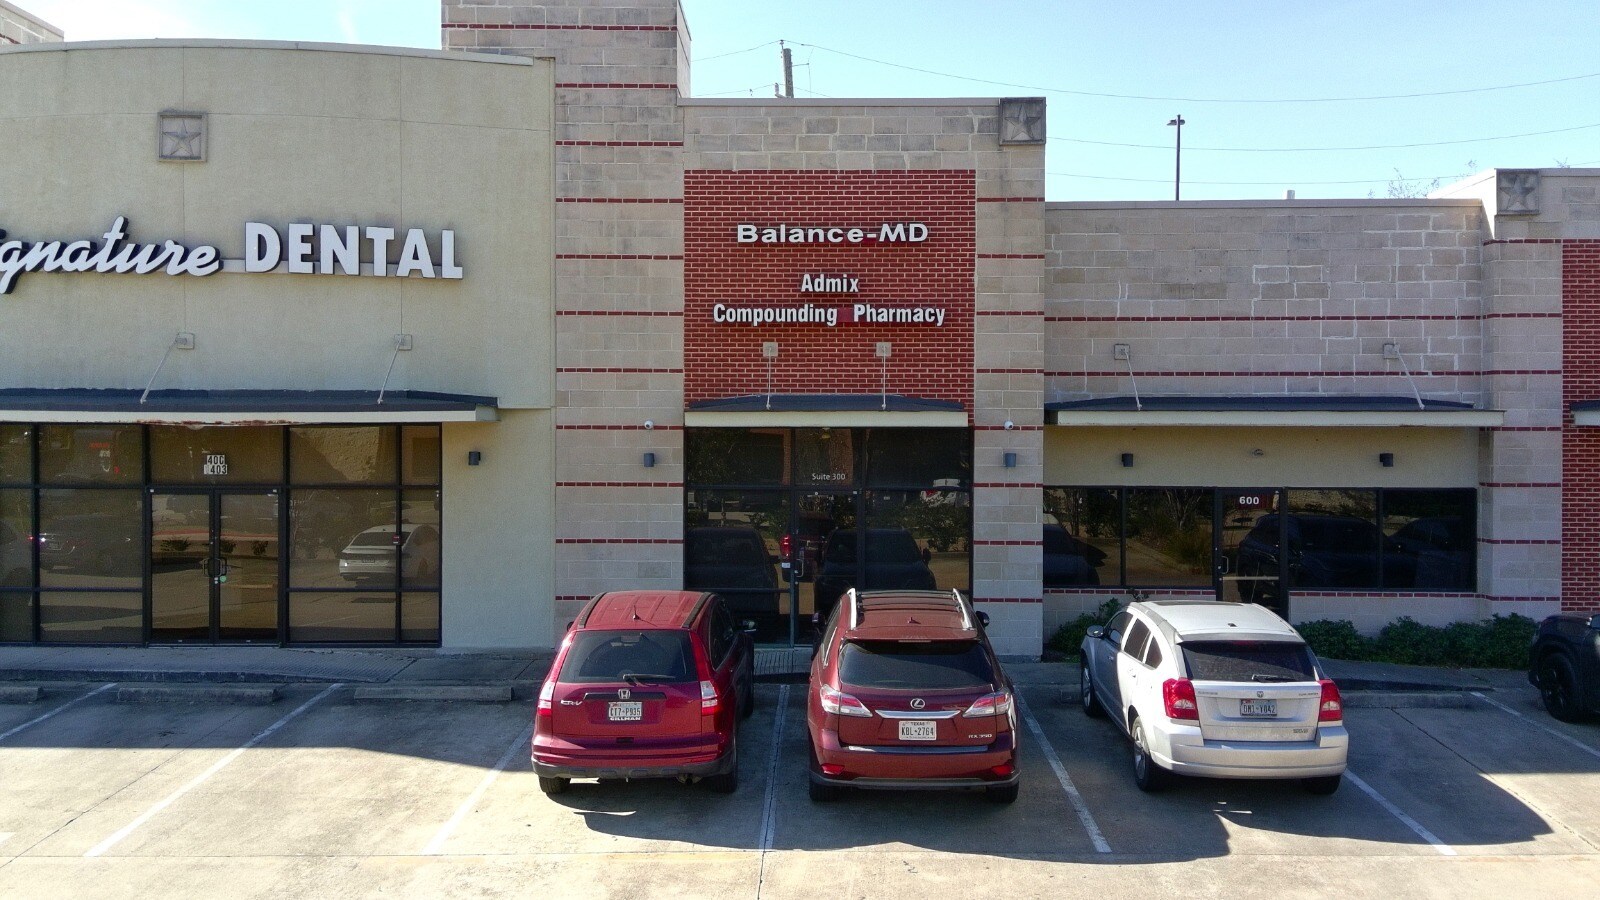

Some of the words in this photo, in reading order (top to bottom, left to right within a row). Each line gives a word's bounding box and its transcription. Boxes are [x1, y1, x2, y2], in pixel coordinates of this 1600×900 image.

[737, 223, 929, 243] Balance-MD
[0, 215, 220, 294] gnature
[244, 221, 463, 280] DENTAL
[801, 274, 859, 293] Admix
[713, 303, 838, 326] Compounding
[853, 303, 946, 326] Pharmacy
[1239, 496, 1260, 505] 600
